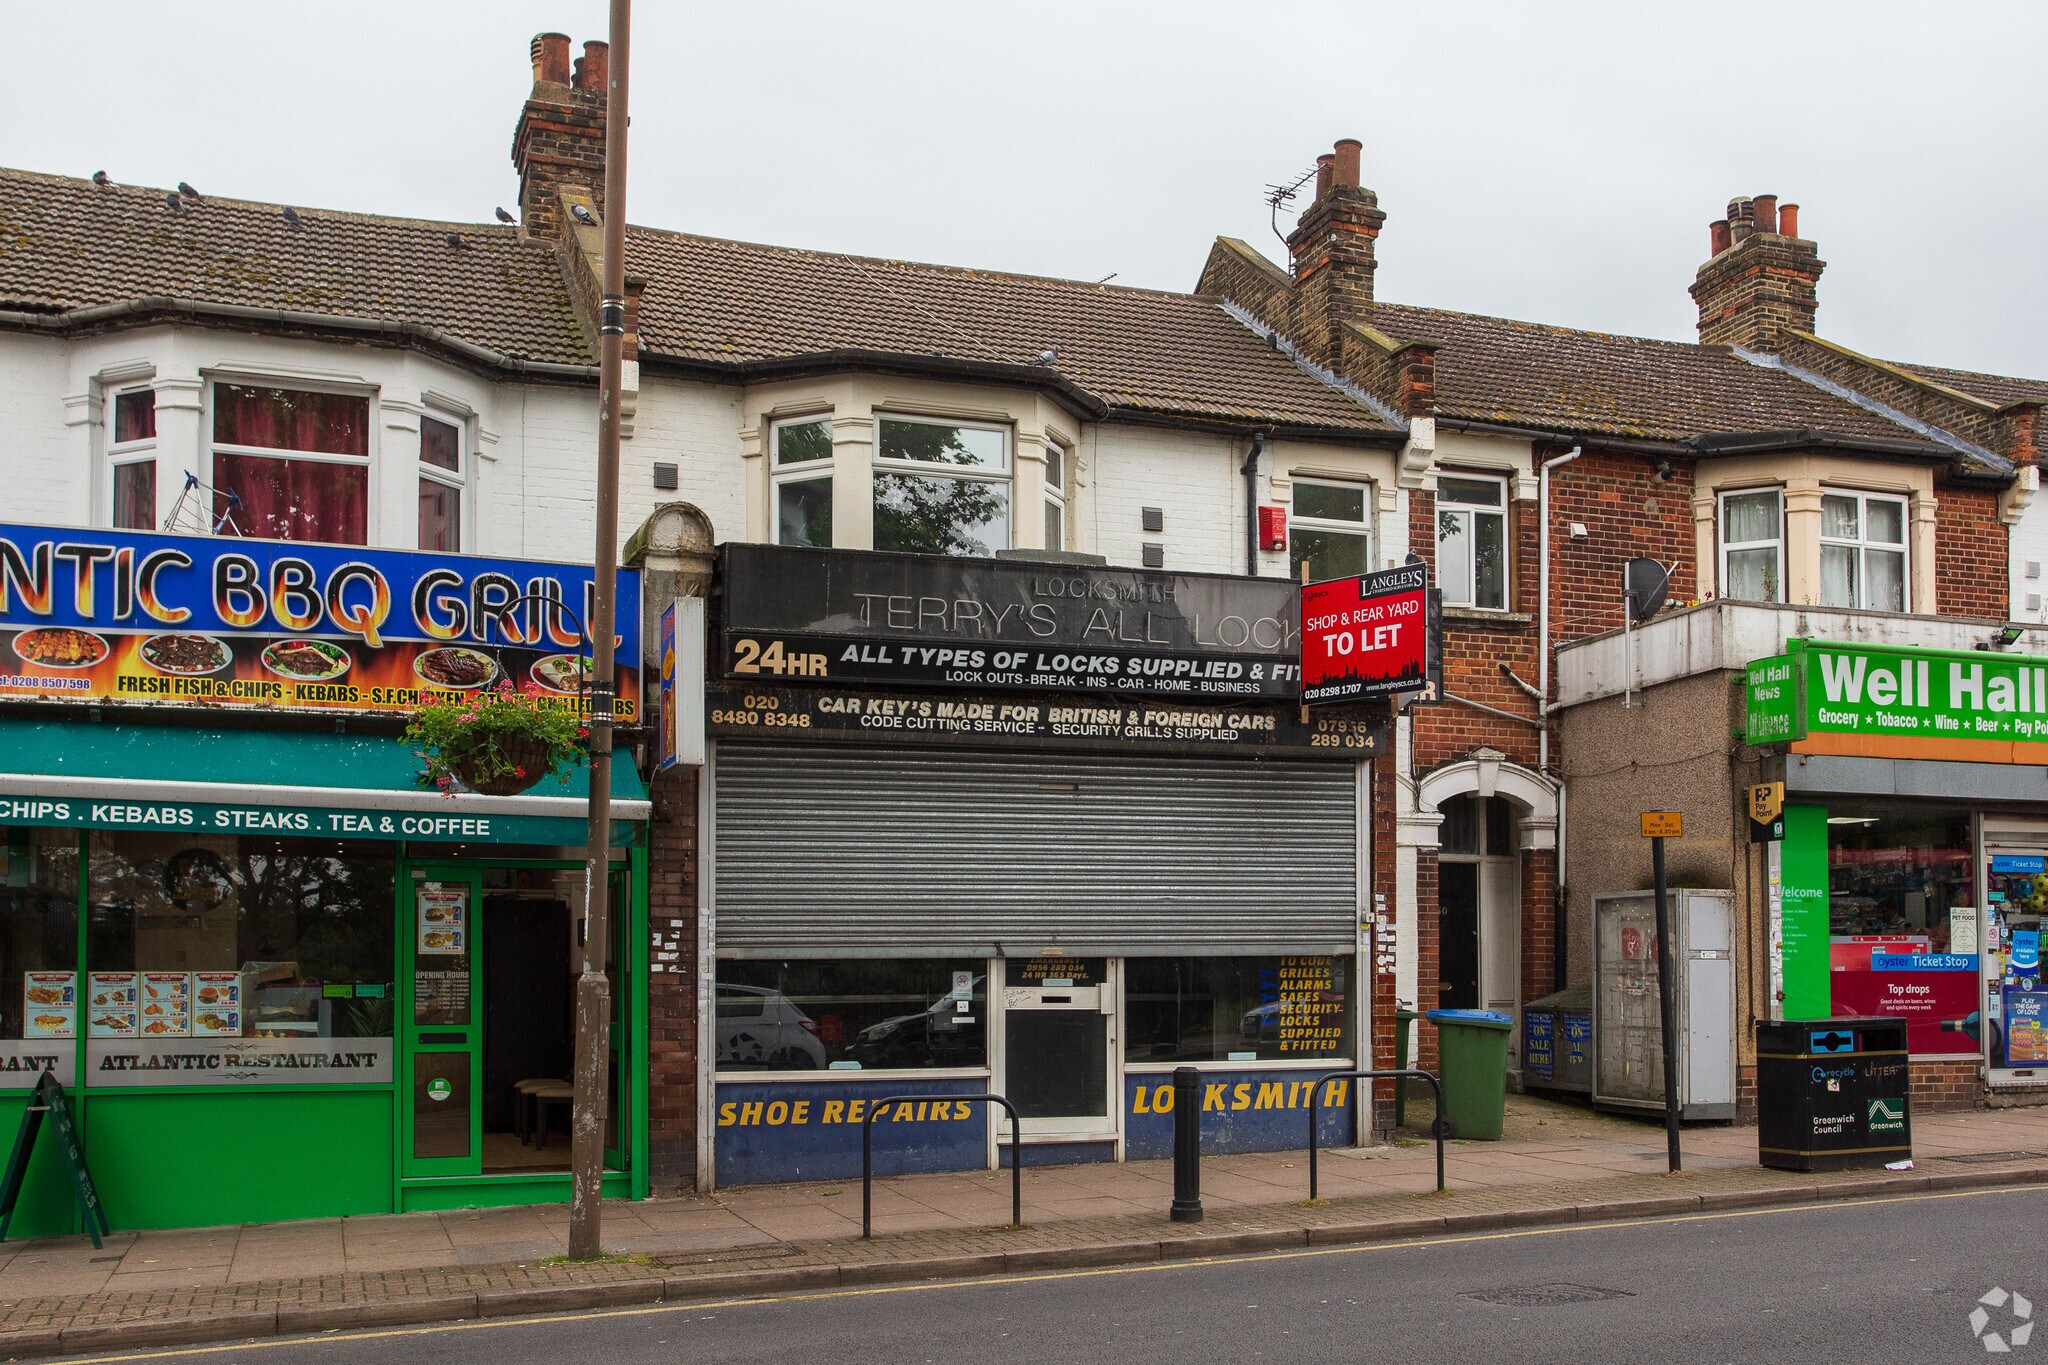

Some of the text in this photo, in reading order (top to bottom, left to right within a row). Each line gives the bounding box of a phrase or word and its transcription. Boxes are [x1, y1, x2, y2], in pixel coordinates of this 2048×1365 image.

[1034, 577, 1177, 602] LOCKSMITH
[1362, 570, 1423, 597] LANGLEYS
[212, 553, 391, 648] BBQ
[853, 594, 1056, 636] TERRY'S
[1083, 608, 1170, 643] ALL
[1307, 600, 1419, 631] SHOP & REAR YARD
[1323, 623, 1402, 657] TO LET
[734, 639, 828, 677] 24HR
[840, 644, 893, 664] ALL
[901, 647, 985, 669] TYPES
[993, 651, 1028, 670] OF
[1036, 653, 1120, 674] LOCKS
[1126, 657, 1243, 679] SUPPLIED
[1249, 663, 1264, 680] &
[1749, 664, 1789, 685] Well Hall
[12, 676, 91, 689] 0208 8507 598
[118, 676, 359, 703] FRESH FISH & CHIPS KEBABS
[945, 671, 982, 683] LOCK
[1086, 676, 1107, 688] INS
[1118, 678, 1144, 689] CAR
[1154, 679, 1191, 691] HOME
[1201, 681, 1261, 694] BUSINESS
[1304, 678, 1421, 699] 020 8298 1707 www.langleyscs.co.uk
[1819, 653, 2046, 713] Well Hall
[1754, 687, 1780, 701] News
[744, 695, 779, 710] 020
[711, 710, 811, 728] 8480 8348
[818, 697, 1276, 731] CAR KEY'S MADE FOR BRITISH & FOREIGN CARS
[861, 715, 1239, 741] CODE CUTTING SERVICE SECURITY GRILLS SUPPLIED
[1819, 708, 1859, 728] Grocery
[1876, 711, 1918, 728] Tobacco
[1935, 714, 1959, 730] Wine
[1975, 716, 1998, 732] Beer
[2014, 719, 2032, 737] Pay
[1311, 734, 1375, 748] 289 034
[1755, 803, 1767, 811] Pay
[1755, 809, 1772, 817] Point
[92, 804, 194, 825] KEBABS
[214, 810, 309, 829] STEAKS
[329, 814, 374, 832] TEA
[379, 816, 395, 833] &
[401, 817, 490, 836] COFFEE
[1878, 955, 1969, 969] oyster Ticket Stop
[415, 971, 470, 979] OPENING HOURS
[1021, 971, 1089, 980] 24 HR 365 Days.
[1280, 968, 1330, 978] GRILLES
[1280, 980, 1331, 990] ALARMS
[1888, 984, 1930, 996] Top drops
[1280, 991, 1320, 1002] SAFES
[1280, 1003, 1341, 1014] SECURITY
[1280, 1015, 1320, 1026] LOCKS
[1280, 1027, 1341, 1039] SUPPLIED
[1533, 1025, 1545, 1036] ON
[1571, 1027, 1583, 1037] ON
[1280, 1040, 1337, 1050] & FITTED
[1530, 1039, 1549, 1050] SALE
[100, 1053, 378, 1070] ATLANTIC RESTAURANT
[1529, 1053, 1550, 1064] HERE
[1826, 1068, 1855, 1078] recycle
[1864, 1066, 1896, 1077] LITTER
[1133, 1080, 1349, 1114] LOKSMITH
[717, 1099, 972, 1126] SHOE REPAIRS
[1813, 1115, 1855, 1125] Greenwich
[1870, 1122, 1903, 1130] Greenwich
[1813, 1125, 1842, 1134] Council
